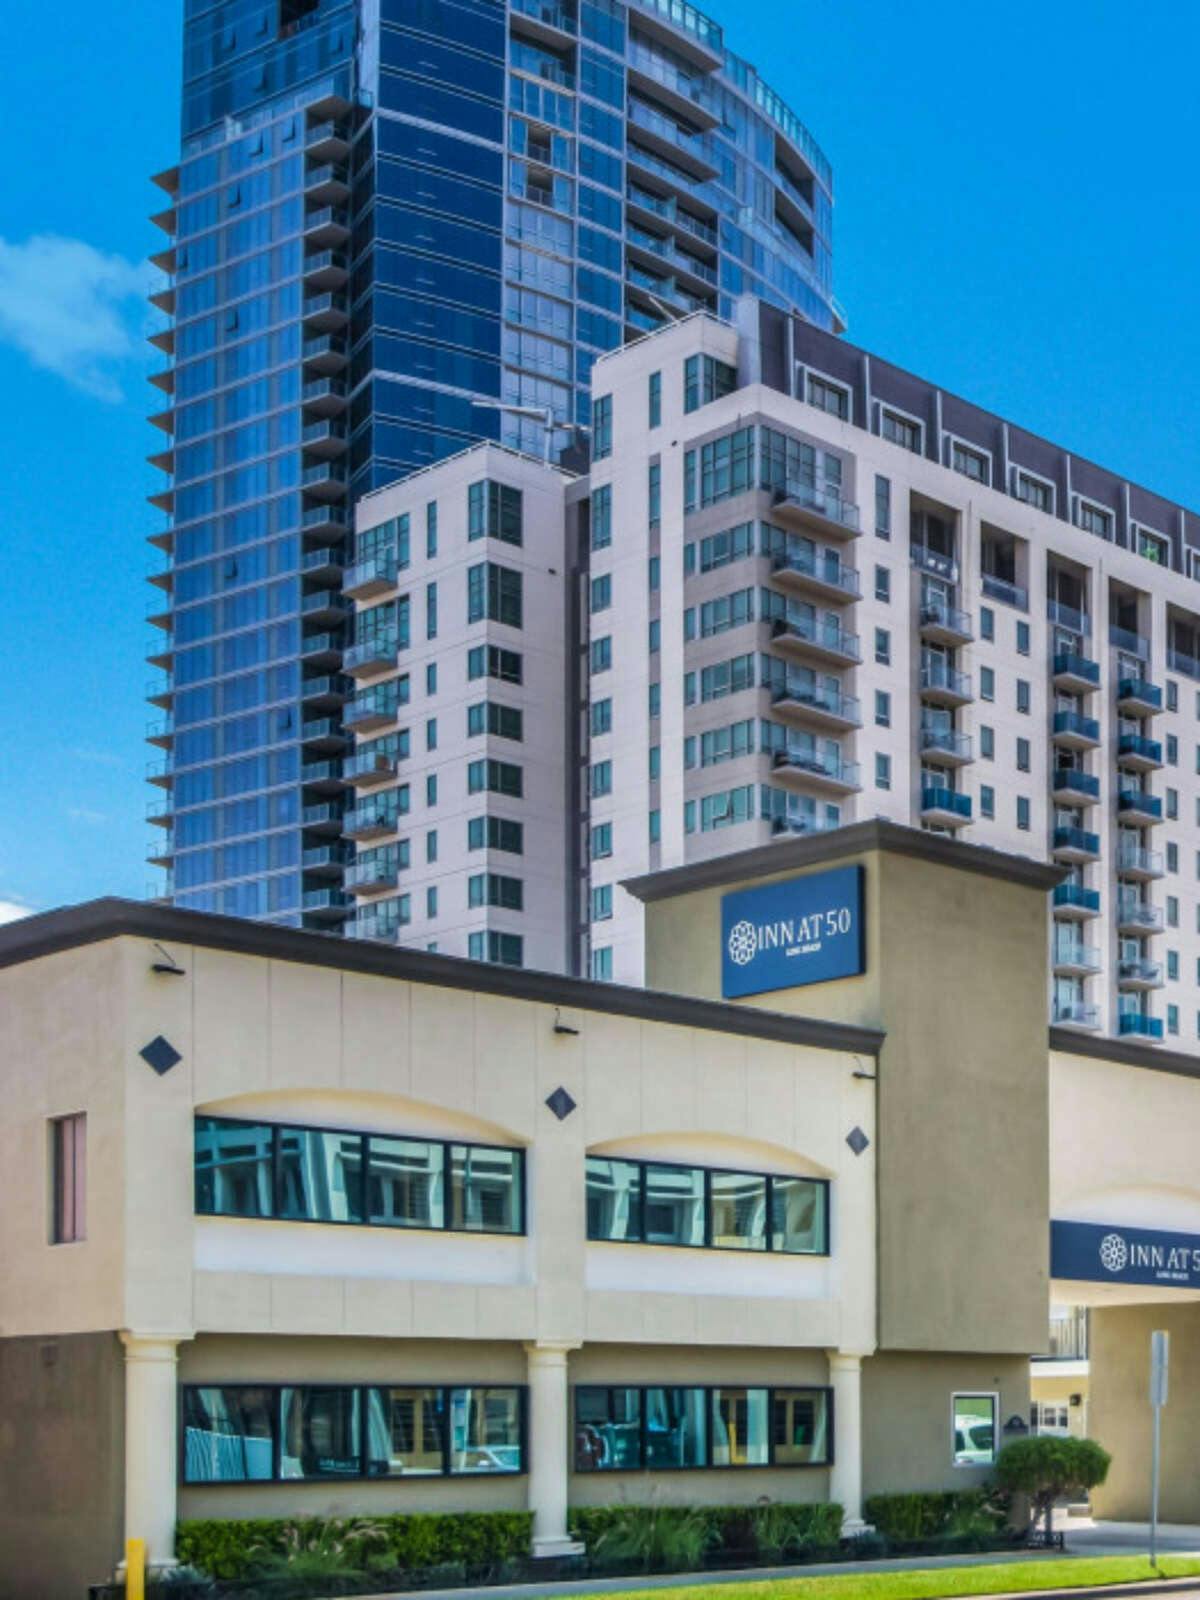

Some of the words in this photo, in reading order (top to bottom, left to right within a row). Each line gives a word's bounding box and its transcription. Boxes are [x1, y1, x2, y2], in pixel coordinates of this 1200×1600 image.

[758, 920, 794, 950] INN
[797, 914, 824, 943] AT
[826, 908, 851, 936] 50
[1130, 1243, 1164, 1268] INN
[1167, 1247, 1191, 1270] AT
